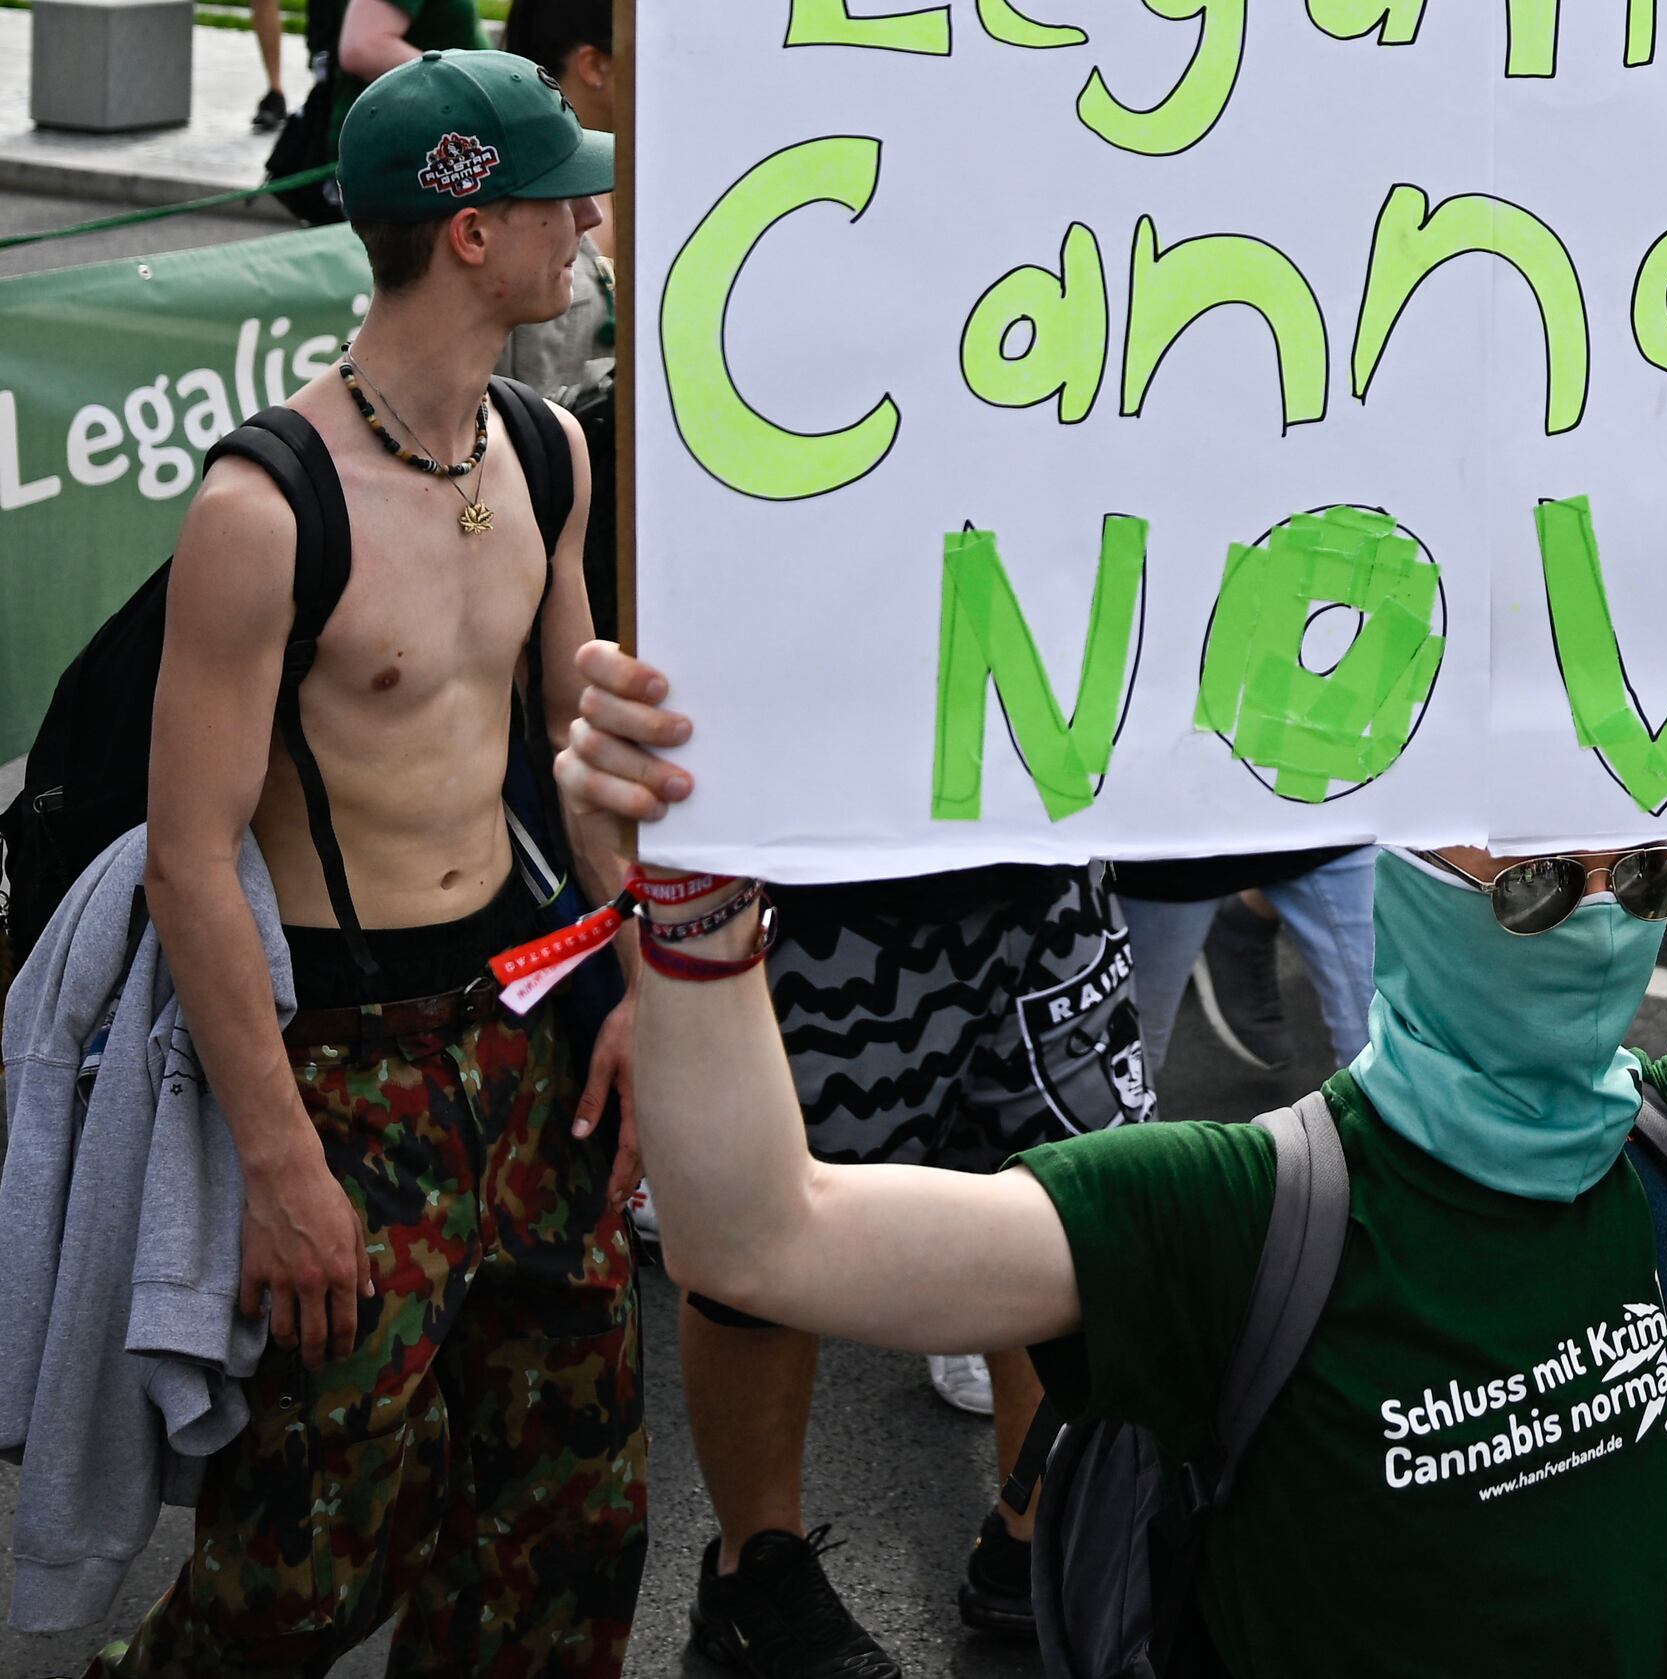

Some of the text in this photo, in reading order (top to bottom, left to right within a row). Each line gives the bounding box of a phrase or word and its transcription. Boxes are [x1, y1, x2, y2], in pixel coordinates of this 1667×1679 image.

[440, 164, 484, 186] GAME
[1380, 1373, 1527, 1441] Schluss
[1532, 1338, 1587, 1394] mit
[1384, 1407, 1563, 1489] Cannabis
[1478, 1434, 1624, 1502] www.hanfverband.de
